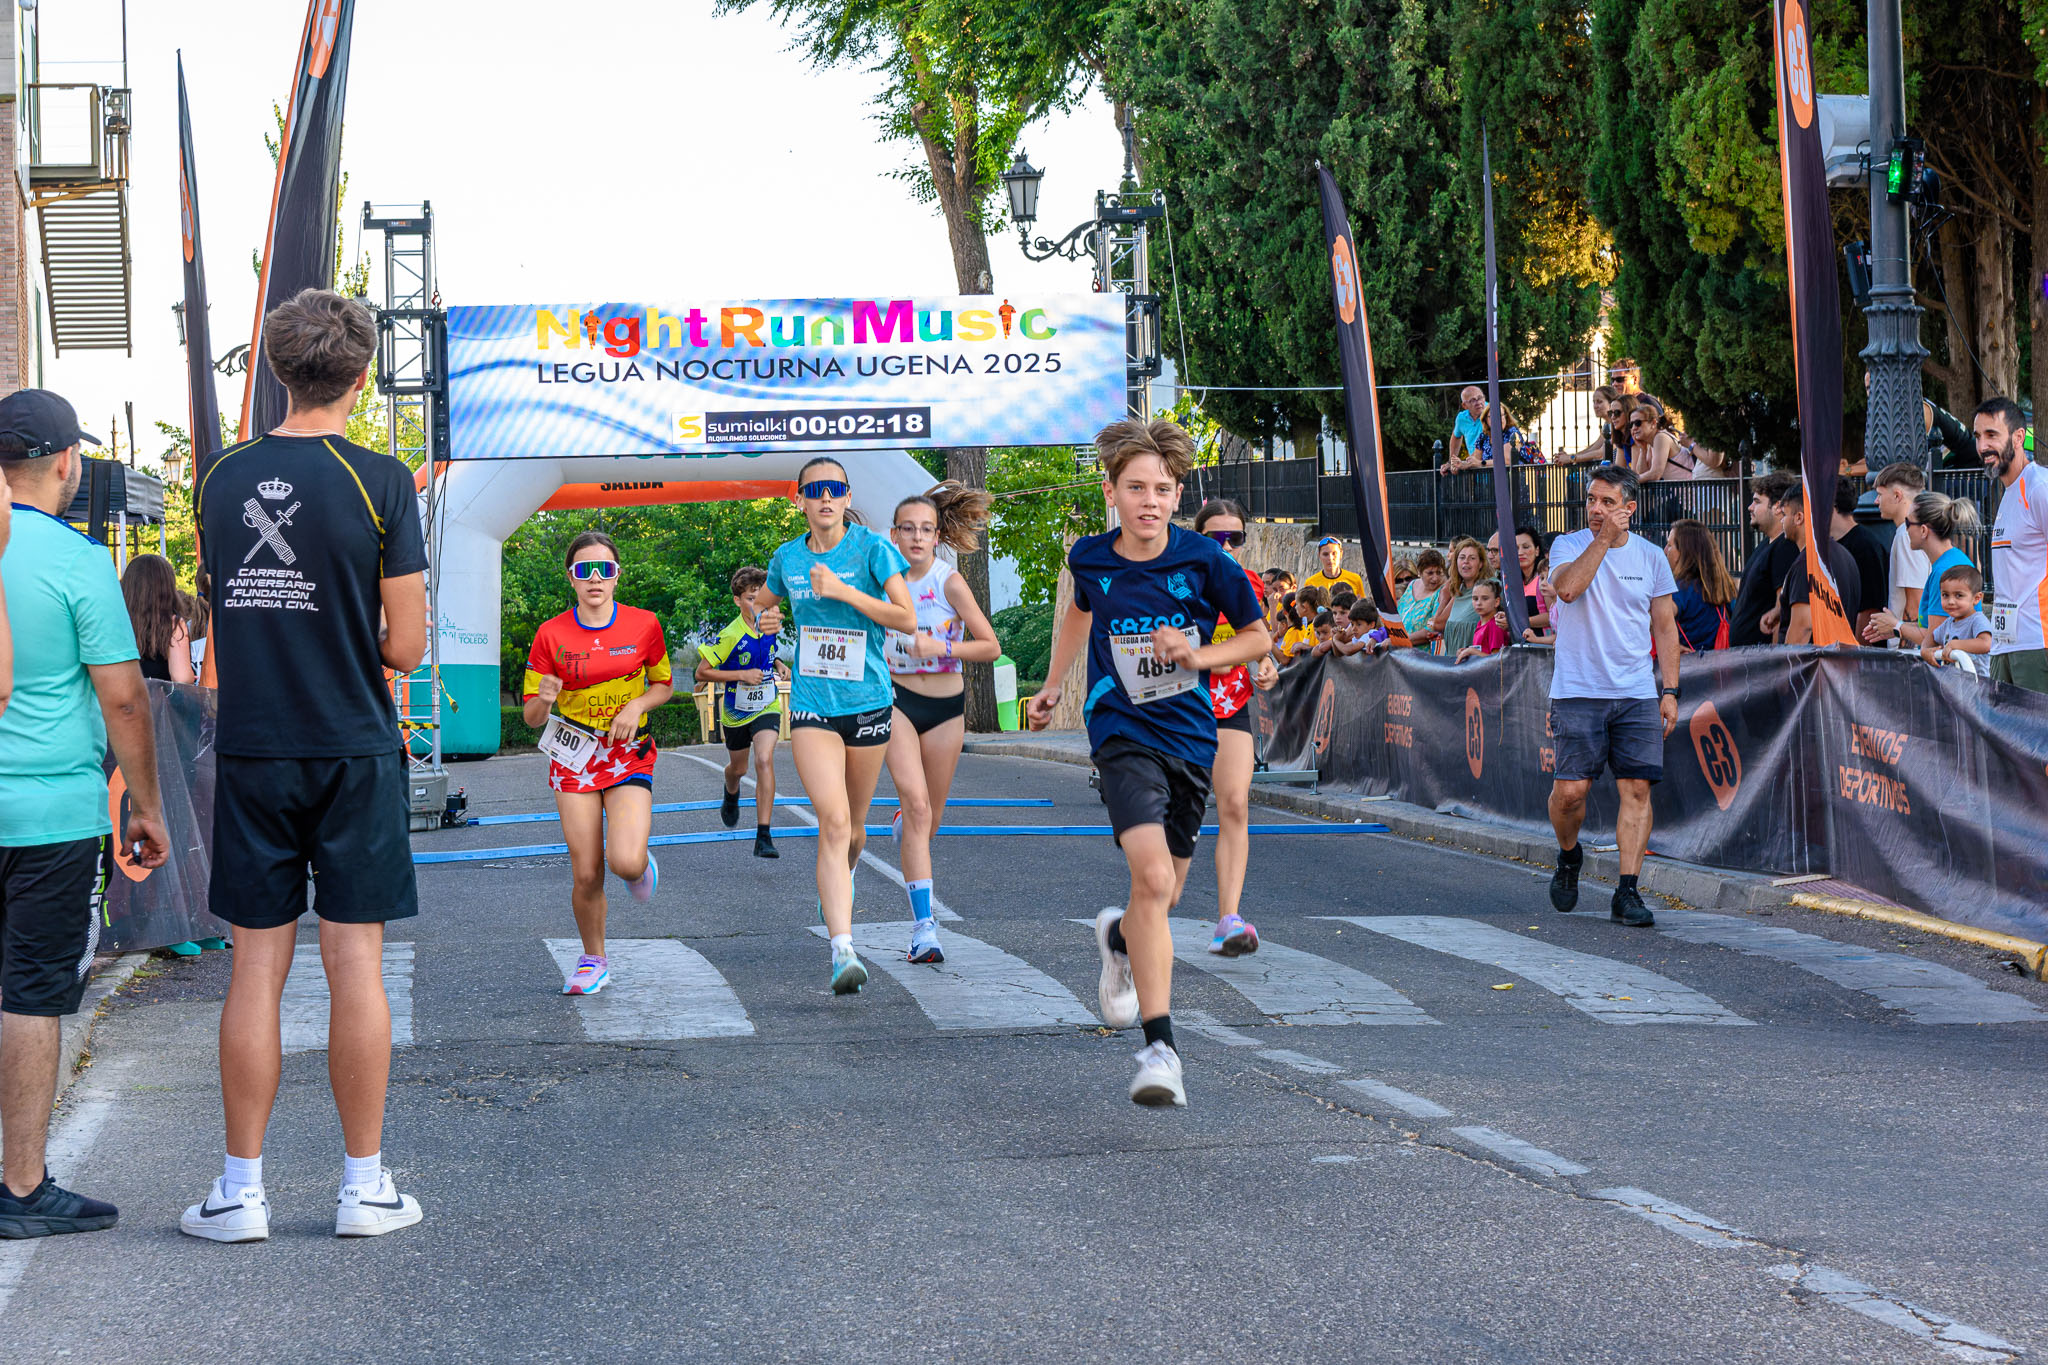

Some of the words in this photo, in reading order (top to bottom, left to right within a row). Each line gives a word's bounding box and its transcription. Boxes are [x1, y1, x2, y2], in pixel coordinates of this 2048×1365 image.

[538, 361, 645, 384] LEGUA
[656, 356, 846, 382] NOCTURNA
[856, 353, 974, 377] UGENA
[984, 352, 1062, 374] 2025
[707, 417, 787, 434] sumialki
[789, 413, 924, 436] 00:02:18
[707, 434, 748, 442] ALQUILAMOS
[748, 433, 787, 441] SOLUCIONES
[238, 568, 304, 580] CARRERA
[226, 578, 316, 591] ANIVERSARIO
[232, 588, 310, 600] FUNDACIÓN
[224, 599, 283, 609] GUARDIA
[285, 600, 320, 612] CIVIL
[459, 636, 489, 645] TOLEDO
[1120, 635, 1139, 645] LEGUA
[817, 643, 847, 661] 484
[746, 690, 764, 701] 483
[554, 726, 581, 751] 490
[244, 1191, 259, 1199] NIKE
[344, 1189, 360, 1197] NIKE
